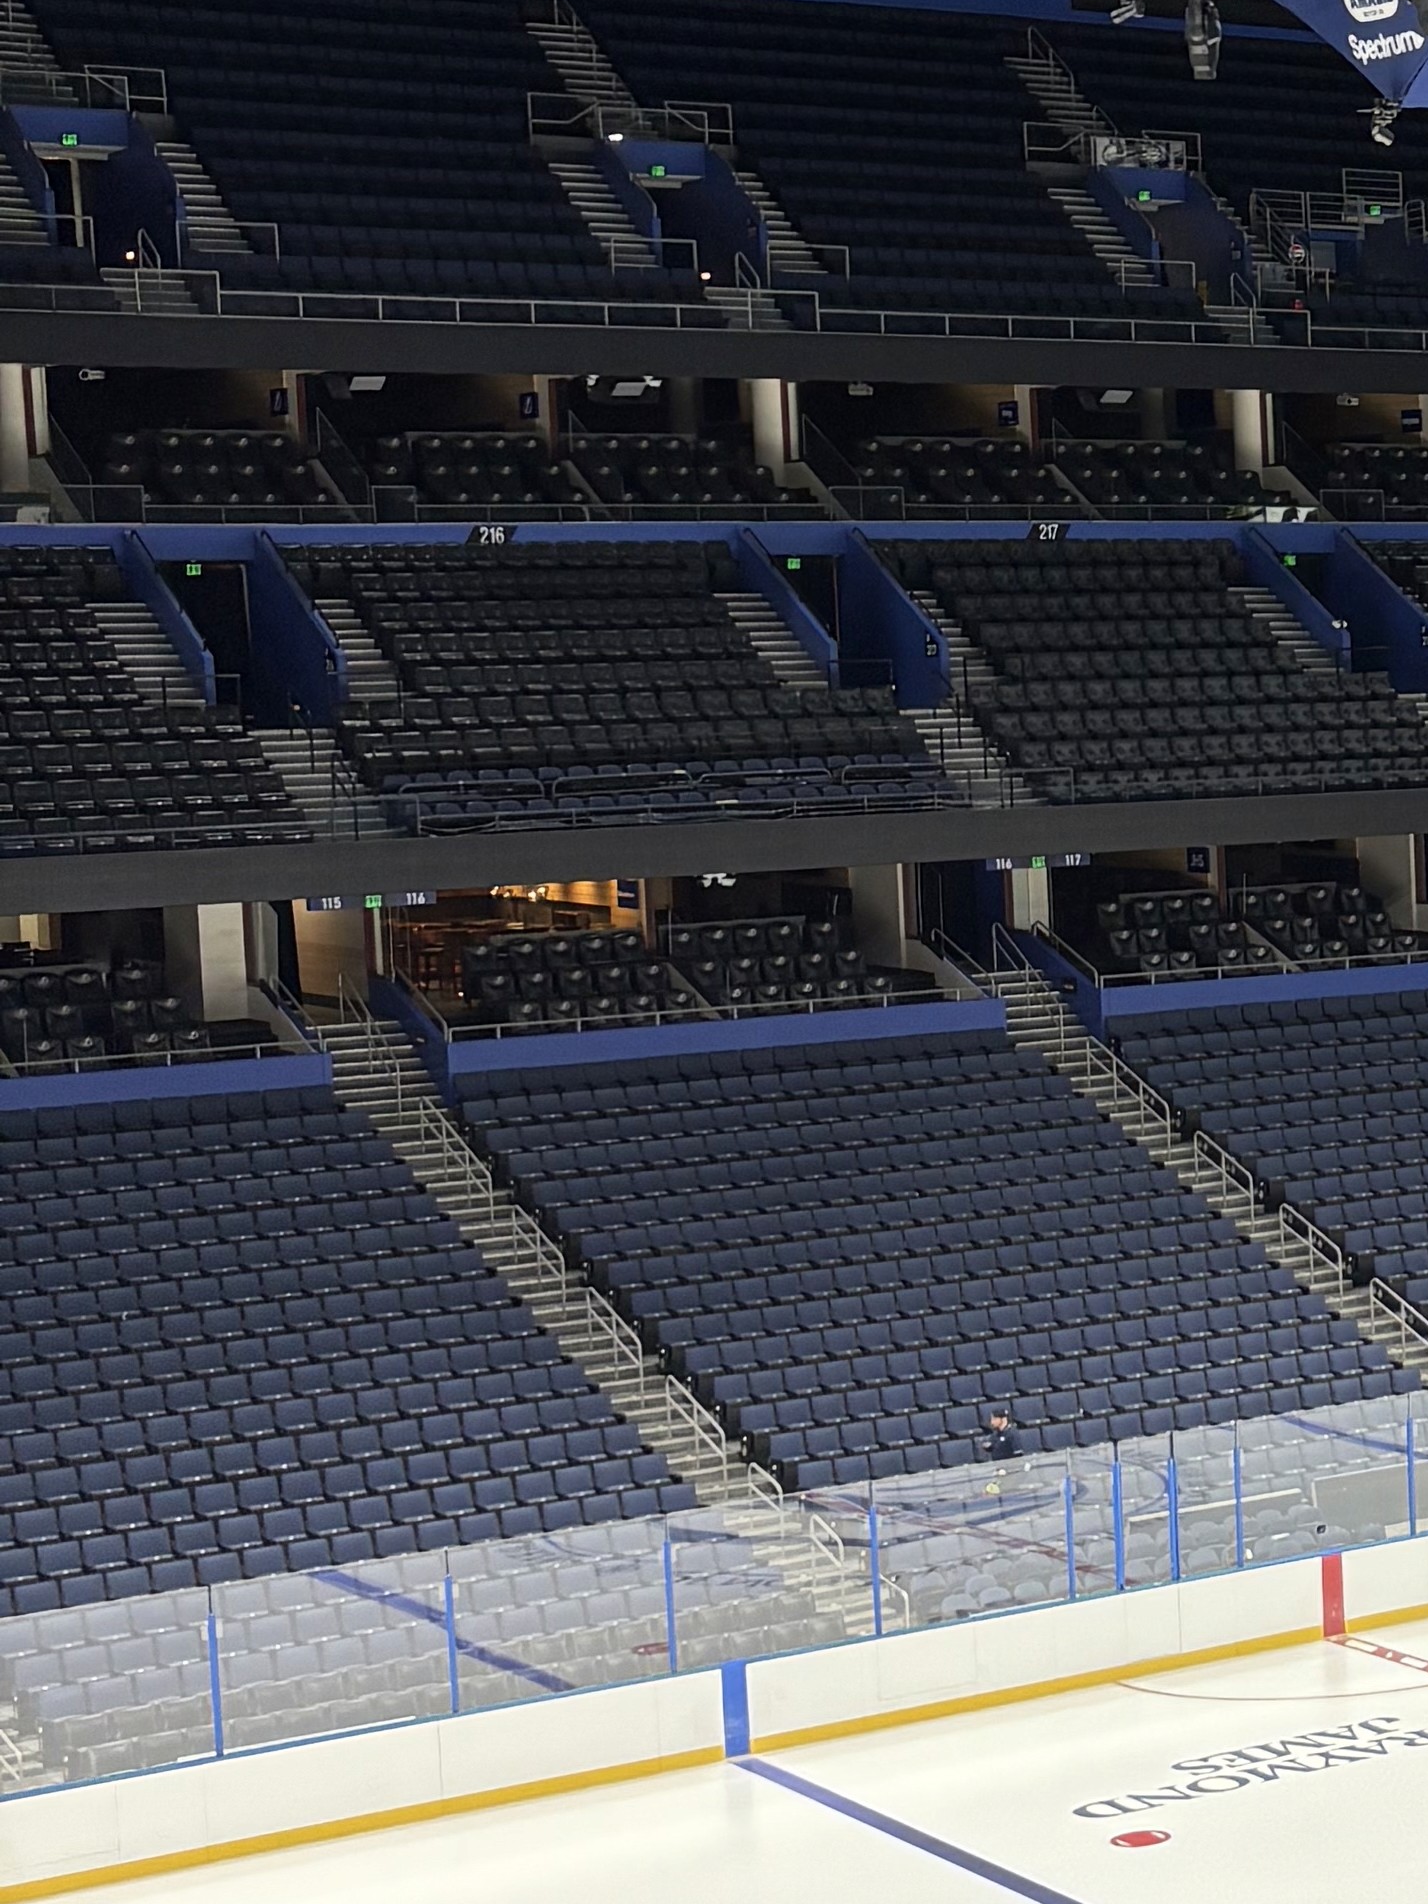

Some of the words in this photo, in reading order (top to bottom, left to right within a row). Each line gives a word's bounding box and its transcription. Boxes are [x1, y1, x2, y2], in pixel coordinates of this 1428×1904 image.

[1348, 31, 1424, 66] Spectrum
[480, 526, 505, 544] 216
[1038, 523, 1059, 540] 217
[996, 857, 1013, 870] 116
[1064, 853, 1081, 866] 117
[322, 896, 341, 910] 115
[406, 892, 426, 905] 116
[1171, 1716, 1402, 1775] JAMES
